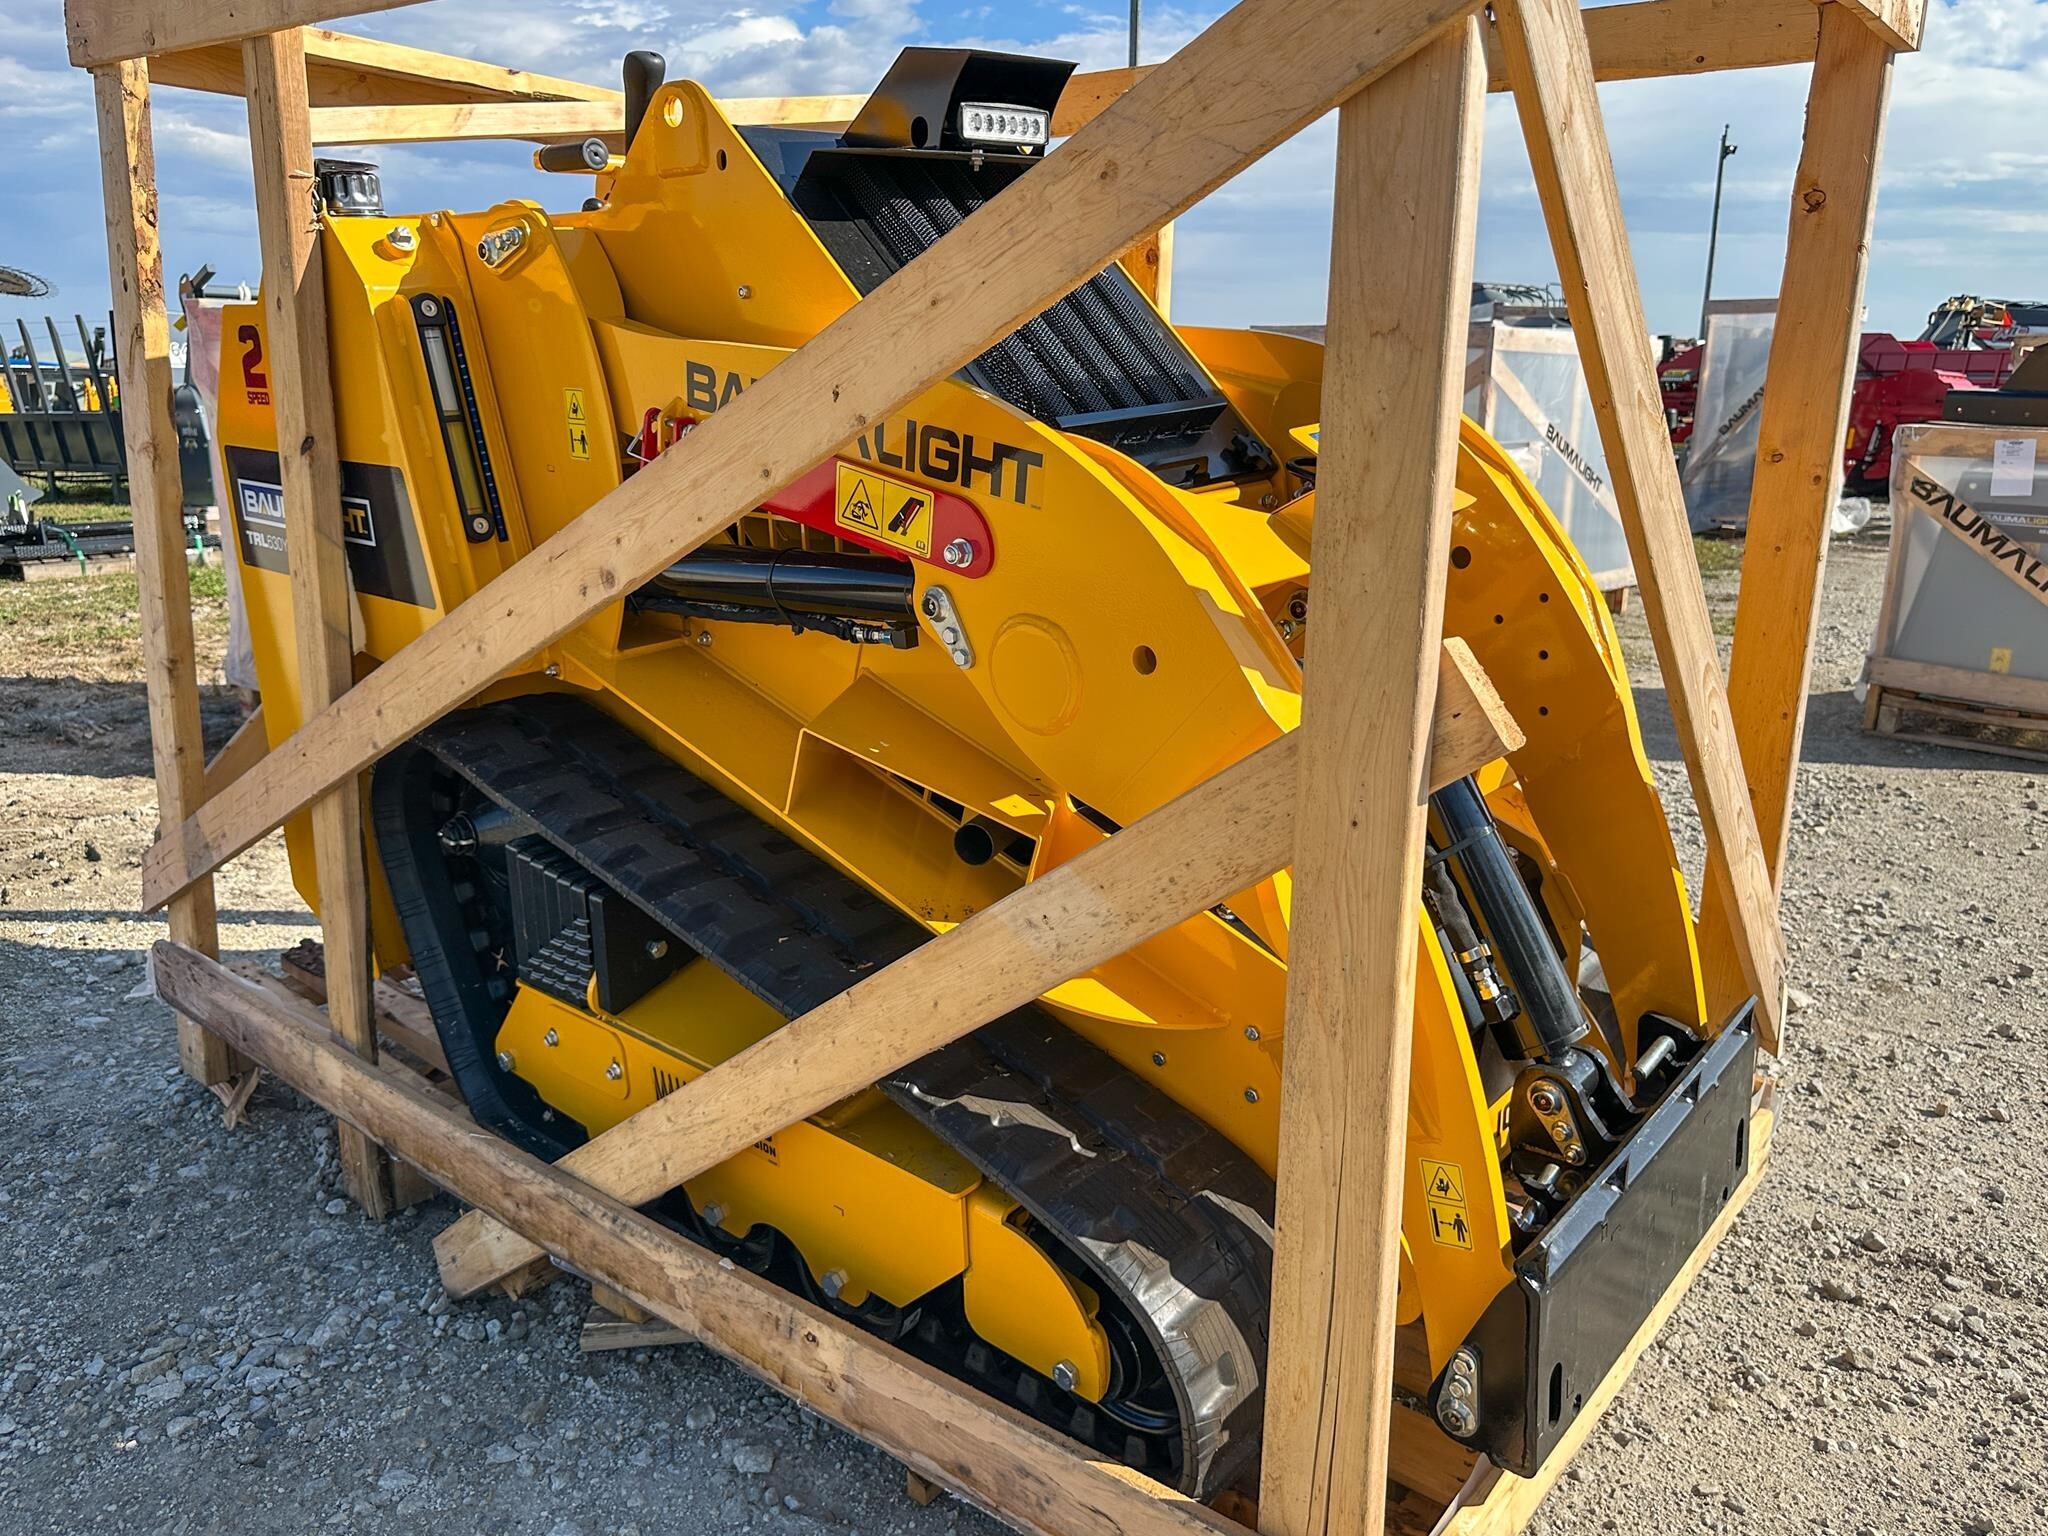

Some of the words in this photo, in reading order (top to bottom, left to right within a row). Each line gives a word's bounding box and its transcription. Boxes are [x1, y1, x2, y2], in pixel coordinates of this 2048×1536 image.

[239, 325, 267, 388] 2
[247, 390, 270, 405] SPEED
[1546, 423, 1602, 492] BAUMALIGHT
